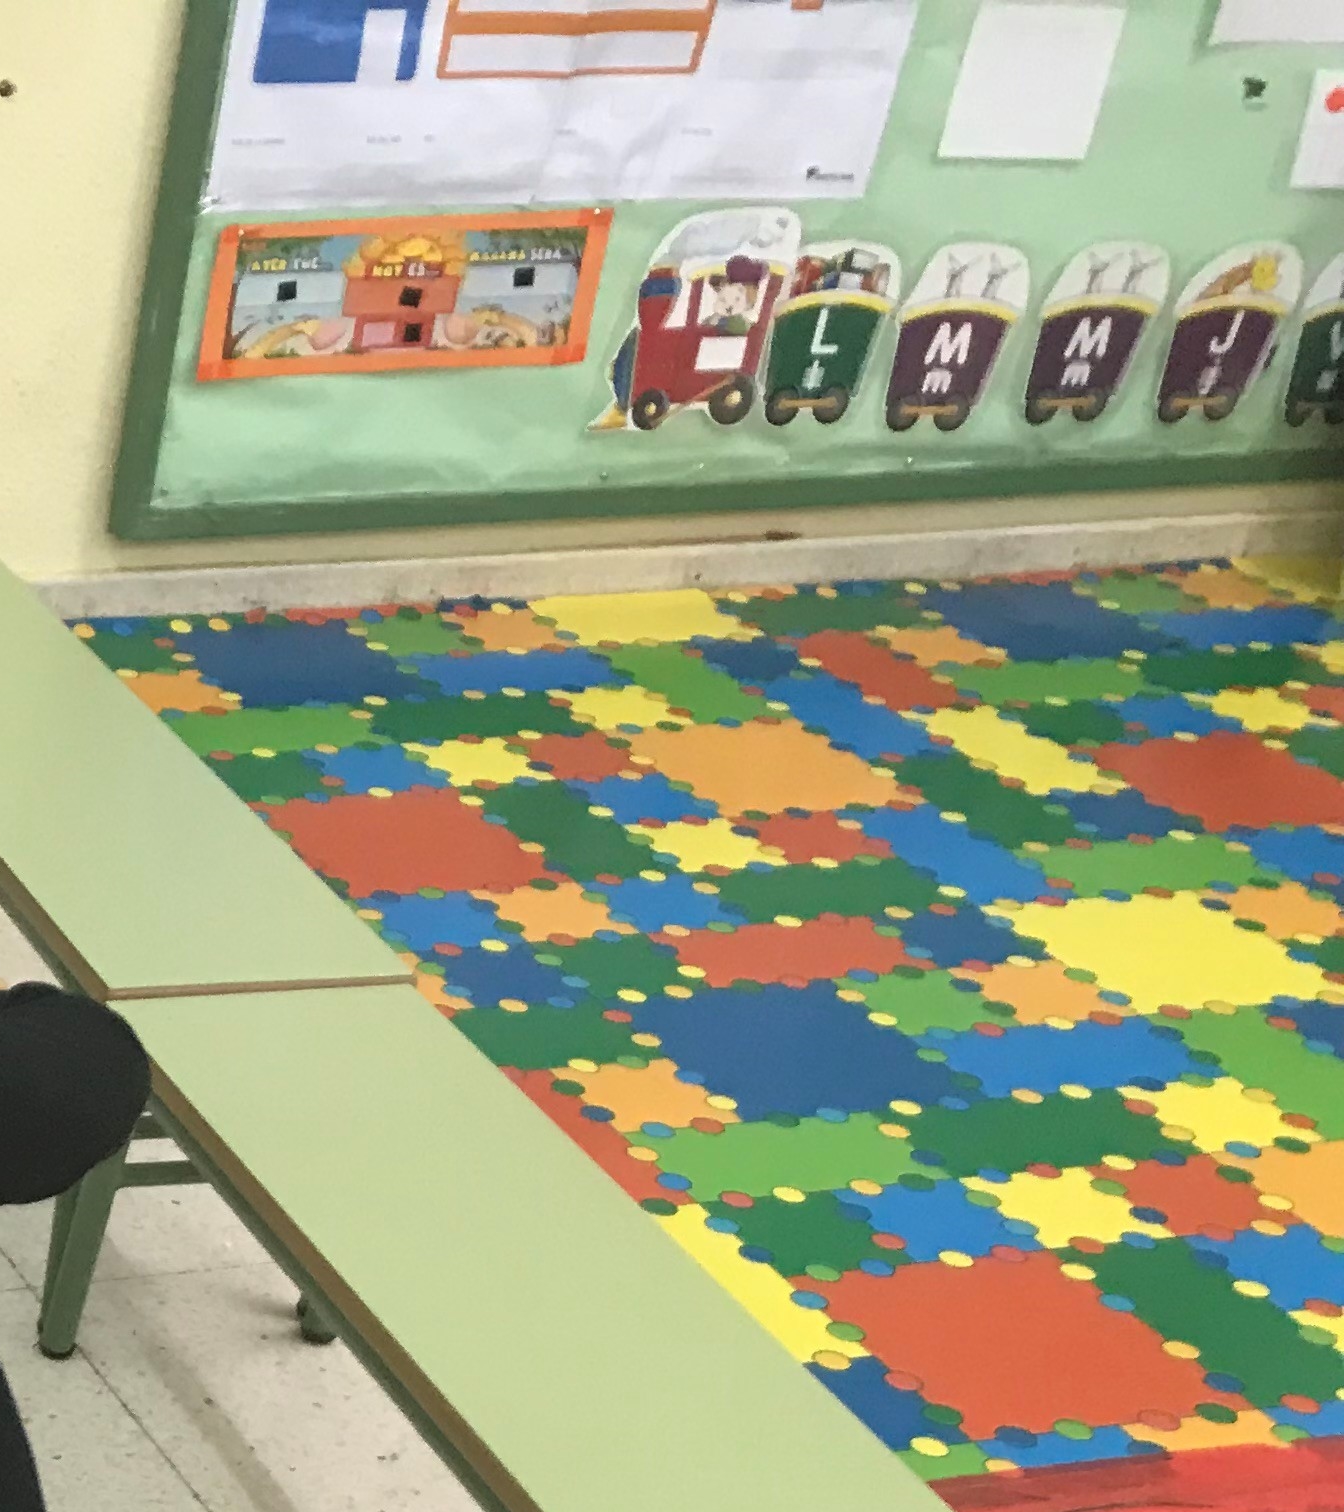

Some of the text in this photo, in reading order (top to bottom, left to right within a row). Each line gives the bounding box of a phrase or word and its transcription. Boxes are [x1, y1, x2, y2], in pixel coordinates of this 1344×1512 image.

[810, 307, 839, 355] L
[924, 321, 973, 365] M
[1063, 316, 1113, 359] M
[1209, 310, 1247, 355] J
